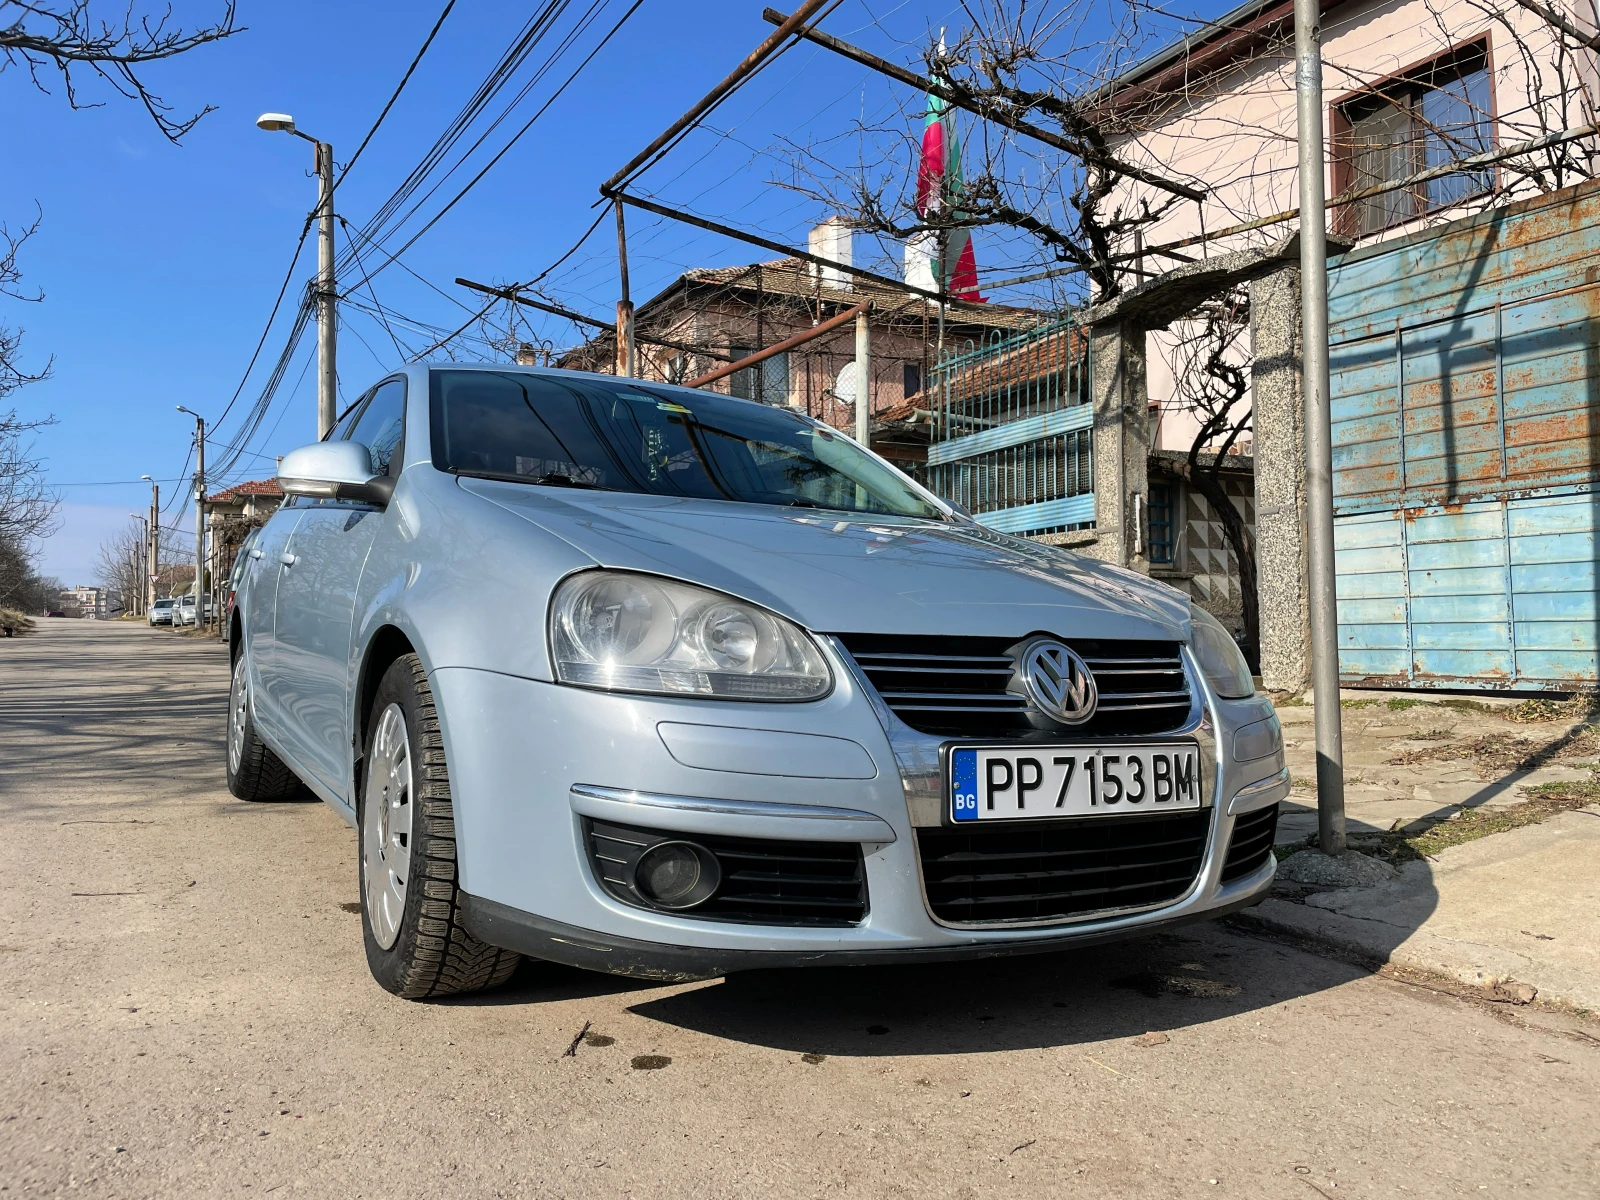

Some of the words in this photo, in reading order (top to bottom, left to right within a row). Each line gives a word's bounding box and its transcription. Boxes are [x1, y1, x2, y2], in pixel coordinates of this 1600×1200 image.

[1025, 643, 1095, 720] VW
[955, 794, 975, 809] BG
[985, 757, 1043, 809] PP
[1052, 754, 1146, 807] 7153
[1152, 753, 1194, 803] BM
